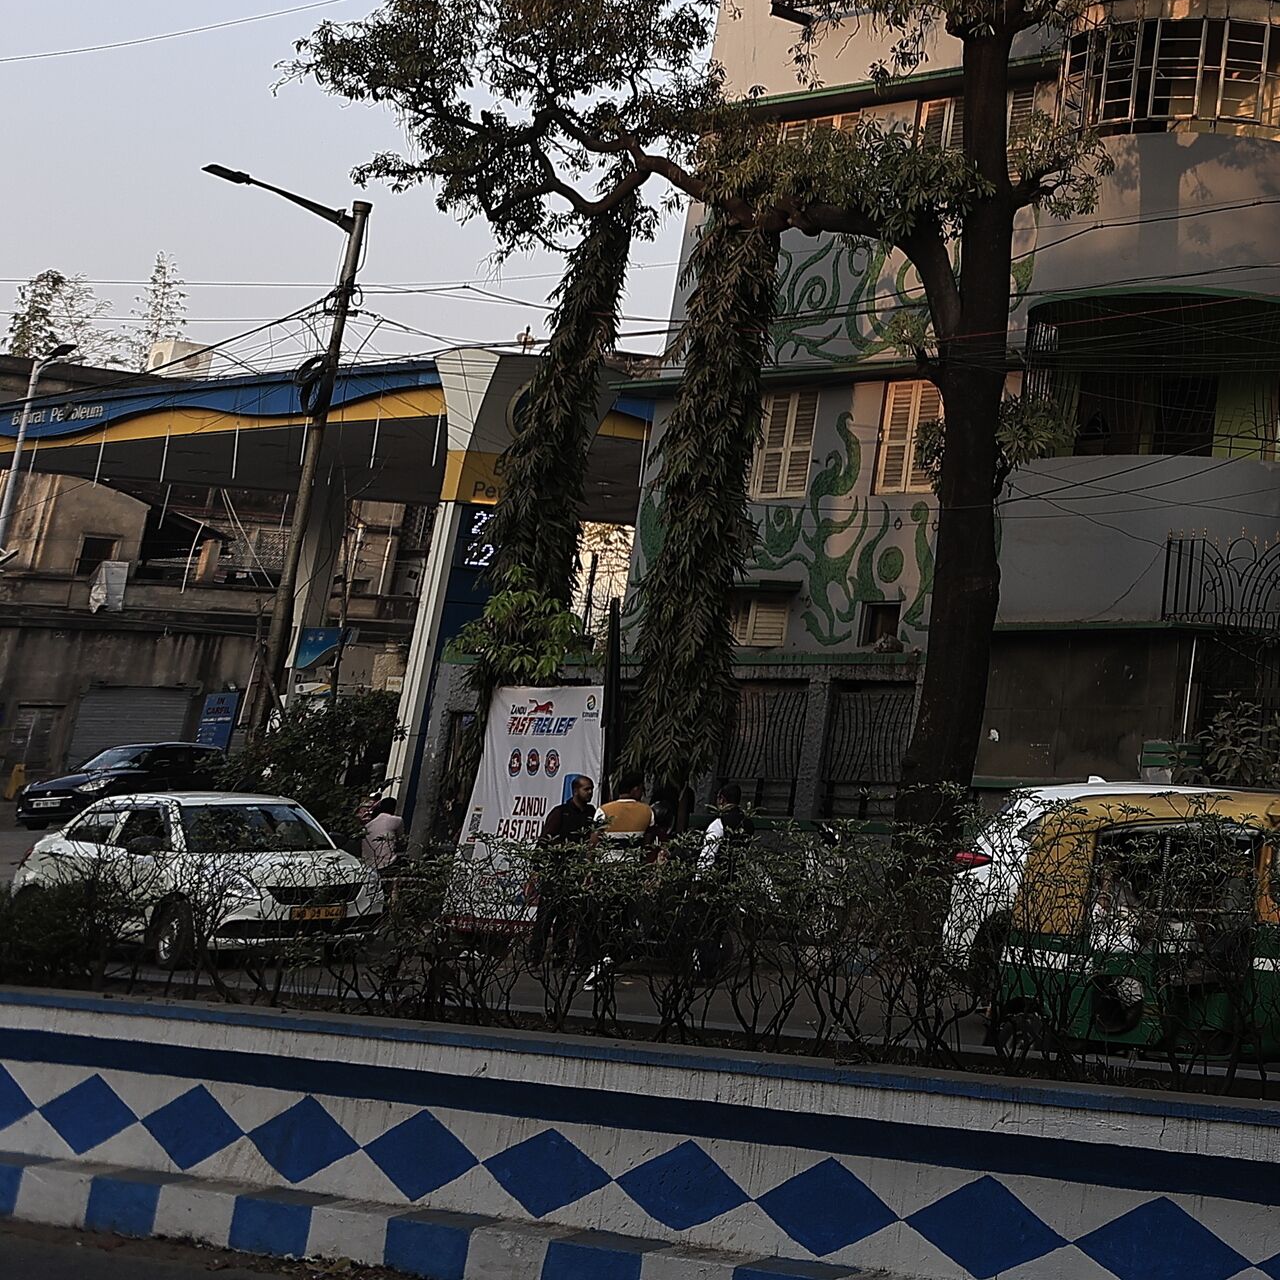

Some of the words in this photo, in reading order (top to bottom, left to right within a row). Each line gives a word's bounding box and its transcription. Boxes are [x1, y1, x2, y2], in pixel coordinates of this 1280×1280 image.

[507, 717, 536, 736] FAST
[532, 717, 577, 736] RELIEF
[512, 796, 547, 817] ZANDU
